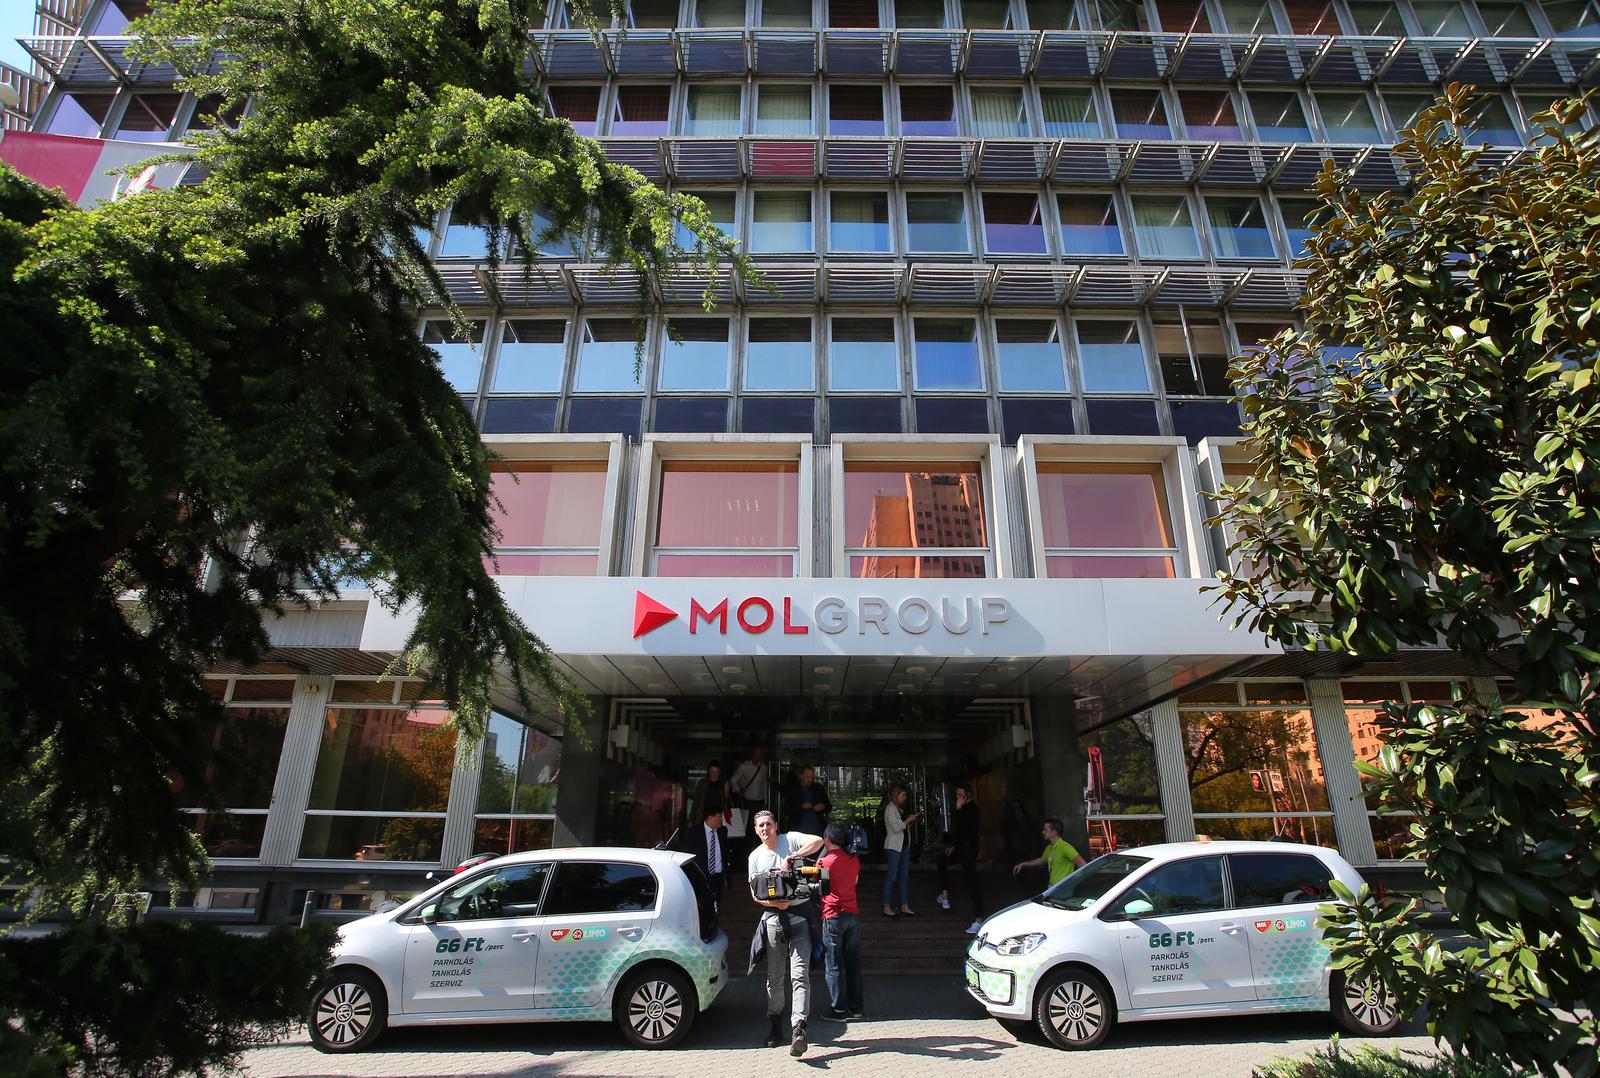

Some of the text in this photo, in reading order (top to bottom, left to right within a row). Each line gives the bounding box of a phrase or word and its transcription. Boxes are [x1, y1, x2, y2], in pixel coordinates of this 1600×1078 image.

[1286, 919, 1306, 928] LIMO
[584, 928, 606, 938] LIMO
[1149, 932, 1173, 948] 66
[1176, 930, 1195, 947] Ft
[435, 938, 461, 953] 66
[463, 937, 486, 952] Ft
[1150, 950, 1190, 961] PARKOLÁS
[433, 957, 474, 966] PARKOLÁS
[1151, 961, 1190, 972] TANKOLÁS
[431, 968, 472, 977] TANKOLÁS
[1152, 973, 1184, 983] SZERVIZ
[429, 979, 463, 988] SZERVIZ
